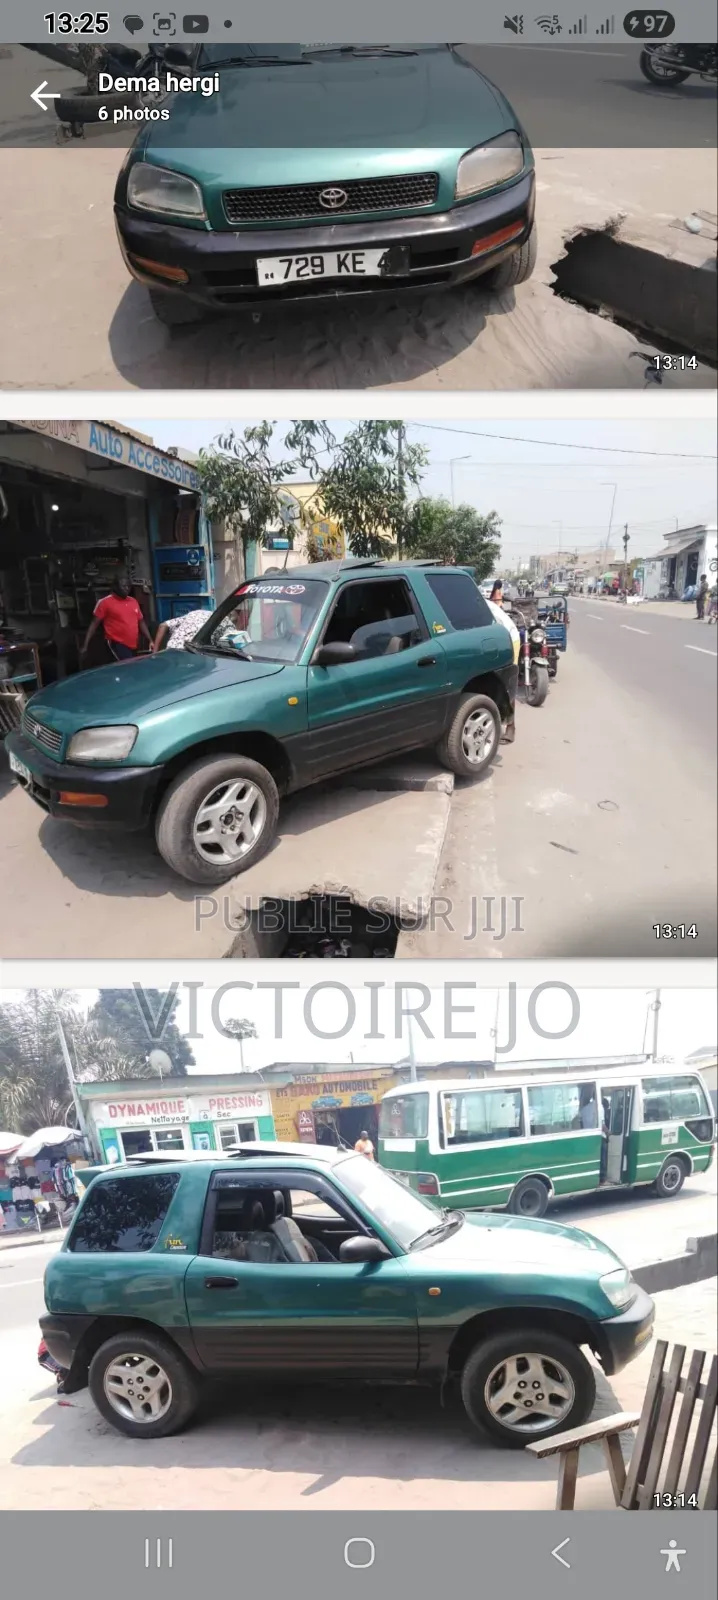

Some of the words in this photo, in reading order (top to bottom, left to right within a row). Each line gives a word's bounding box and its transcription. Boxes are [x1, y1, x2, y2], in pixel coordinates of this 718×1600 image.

[279, 255, 325, 279] 729
[336, 252, 366, 274] KE
[89, 423, 123, 458] Auto
[128, 440, 201, 489] Accessoires
[244, 584, 285, 594] TOYOTA
[322, 1079, 379, 1094] AUTOMOBILE
[108, 1100, 186, 1118] DYNAMIQUE
[208, 1095, 263, 1111] PRESSING
[151, 1115, 190, 1124] Nettoyage
